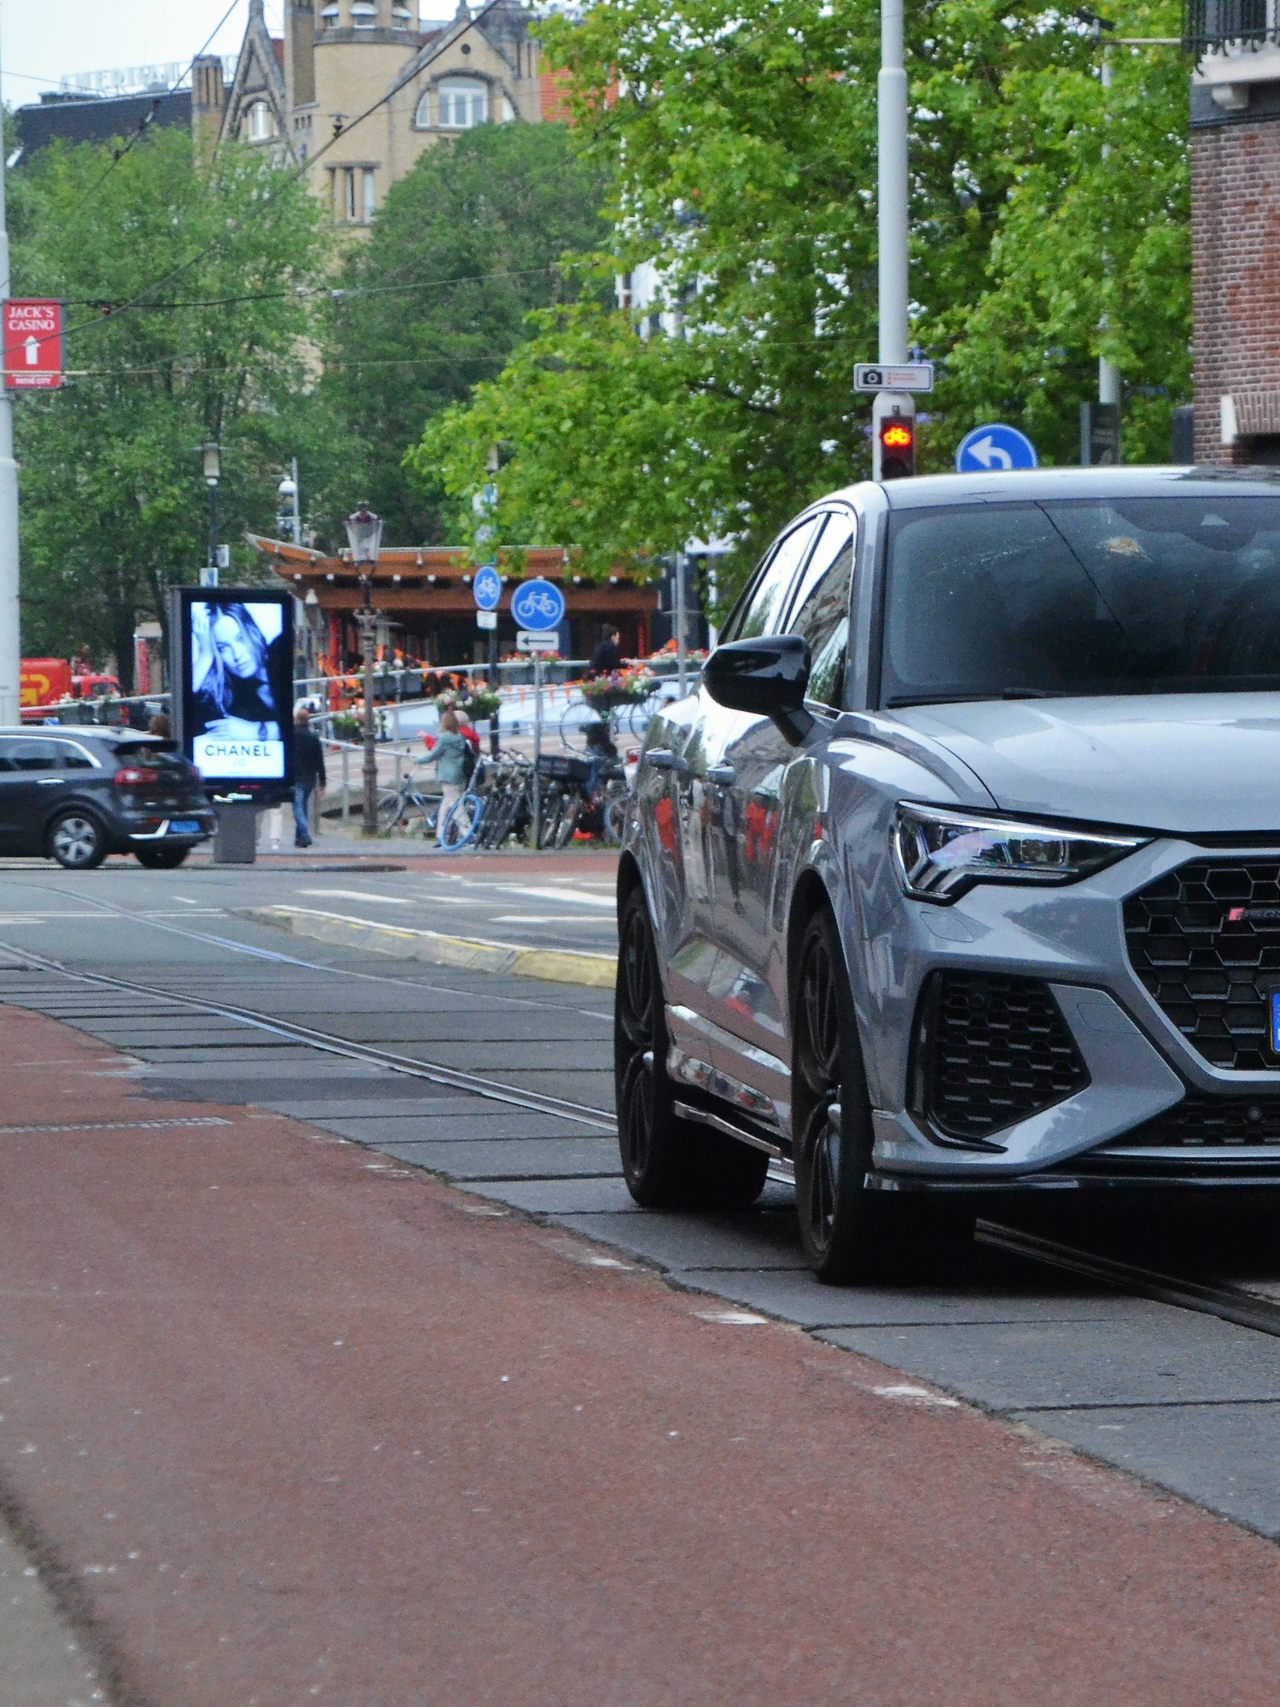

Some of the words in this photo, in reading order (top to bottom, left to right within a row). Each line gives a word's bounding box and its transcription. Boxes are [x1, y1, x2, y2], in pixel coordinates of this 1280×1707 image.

[9, 306, 54, 318] JACK'S
[9, 319, 55, 331] CASINO
[205, 744, 272, 757] CHANEL
